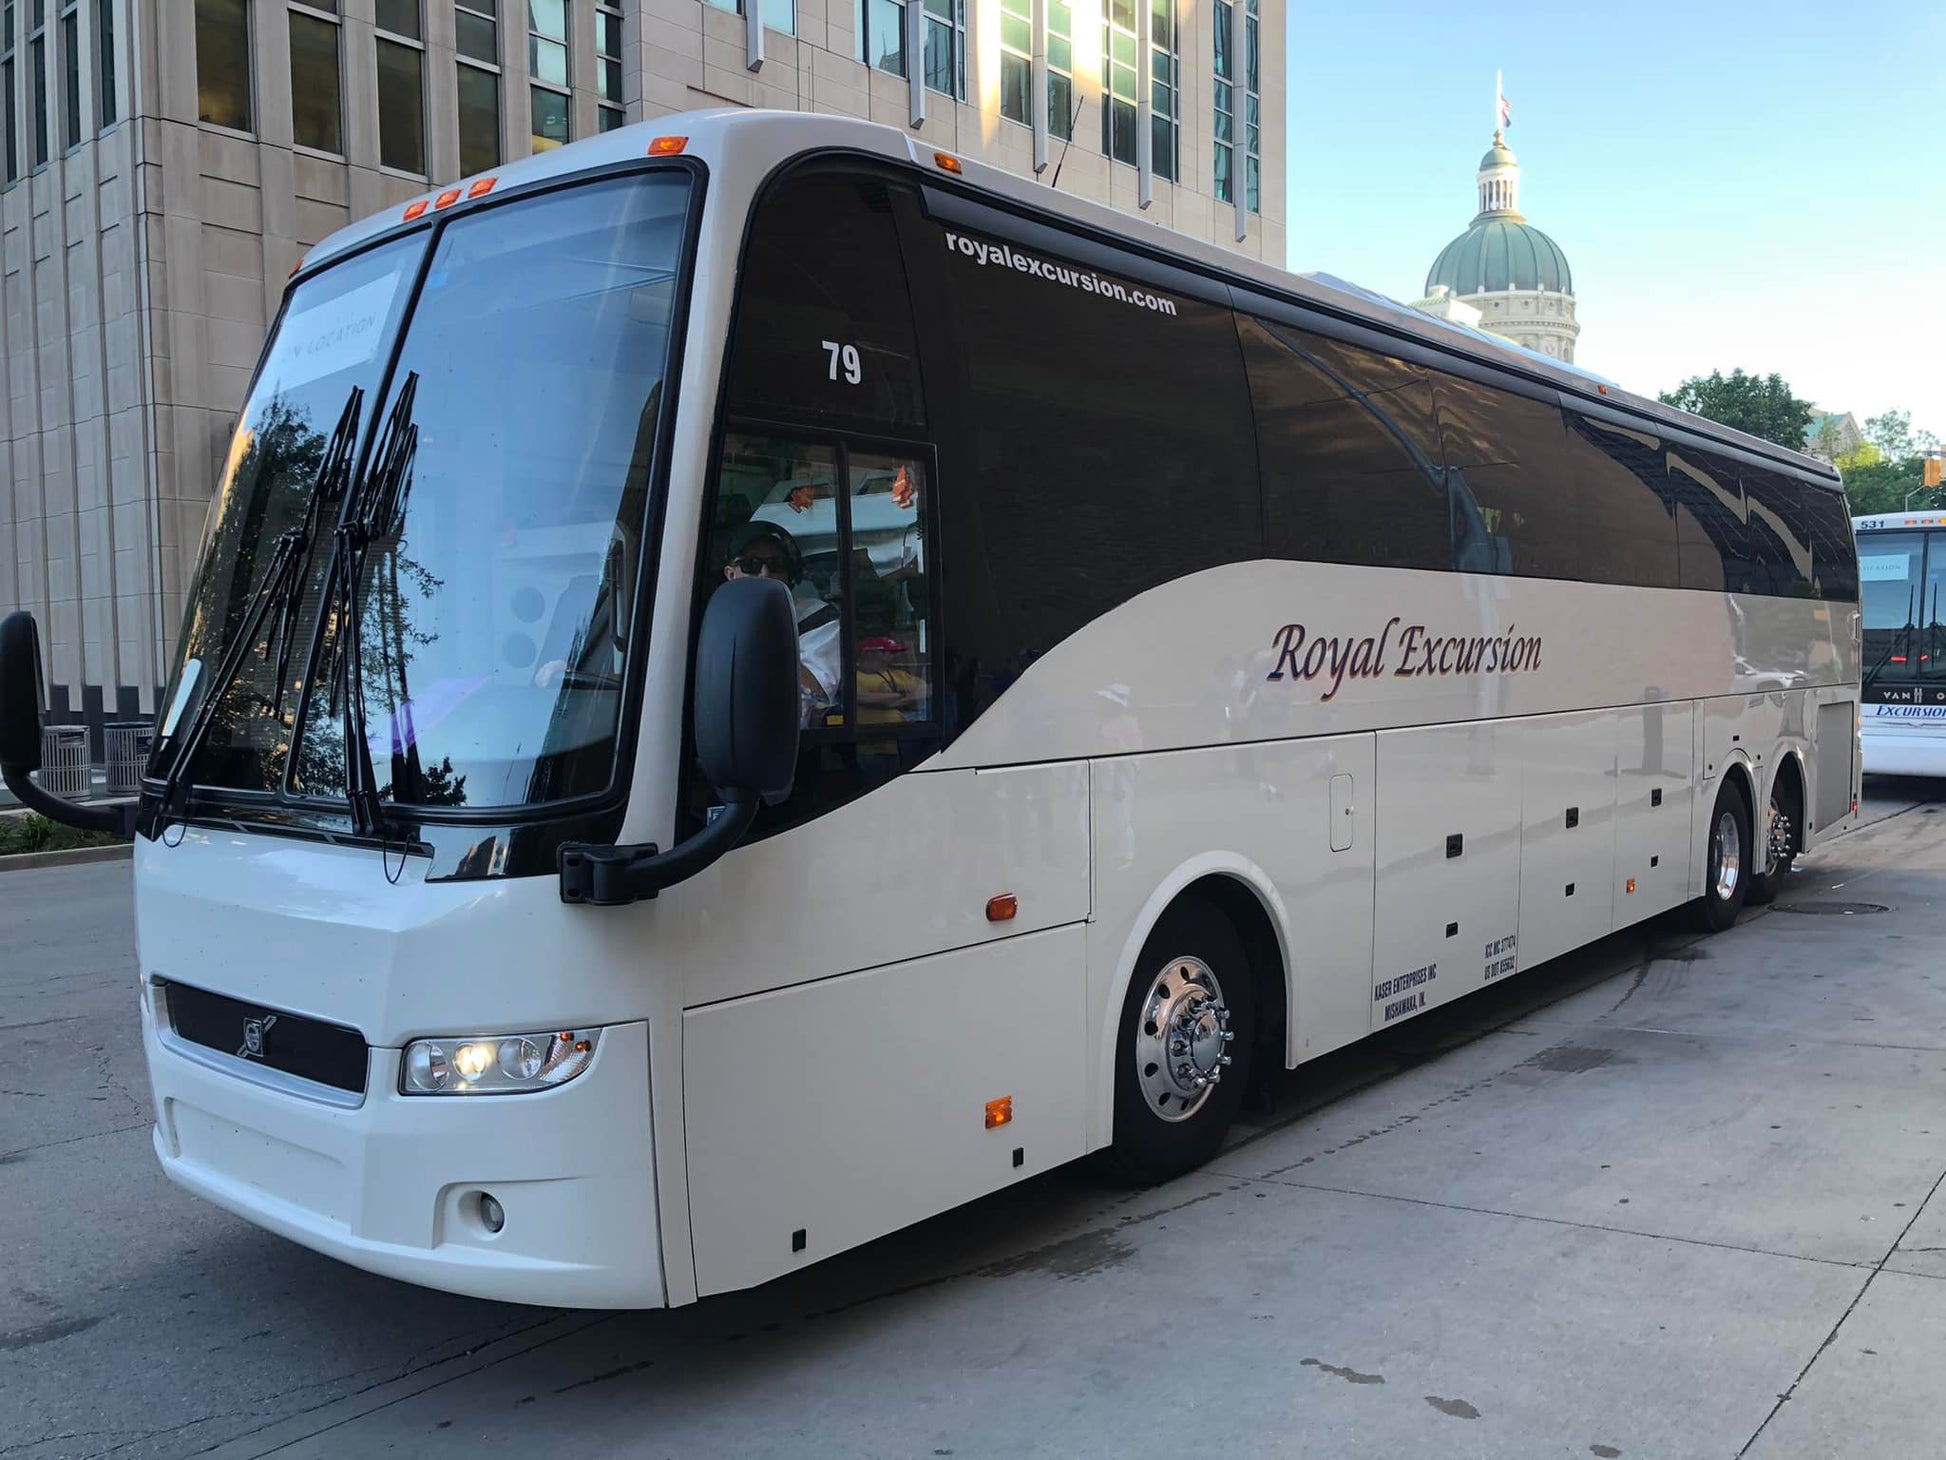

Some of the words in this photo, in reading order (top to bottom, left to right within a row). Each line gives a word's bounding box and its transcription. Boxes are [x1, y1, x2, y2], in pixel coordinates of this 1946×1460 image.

[945, 231, 1177, 316] royalexcursion.com
[822, 341, 861, 384] 79
[1860, 520, 1885, 530] 531
[1267, 617, 1401, 701] Royal
[1393, 624, 1543, 677] Excursion
[1883, 691, 1911, 700] VAN
[1374, 980, 1393, 1001] KASER
[1393, 967, 1427, 994] ENTERPRISES
[1428, 963, 1437, 981] INC
[1485, 965, 1491, 980] US
[1385, 994, 1418, 1021] MISHAWAKA,
